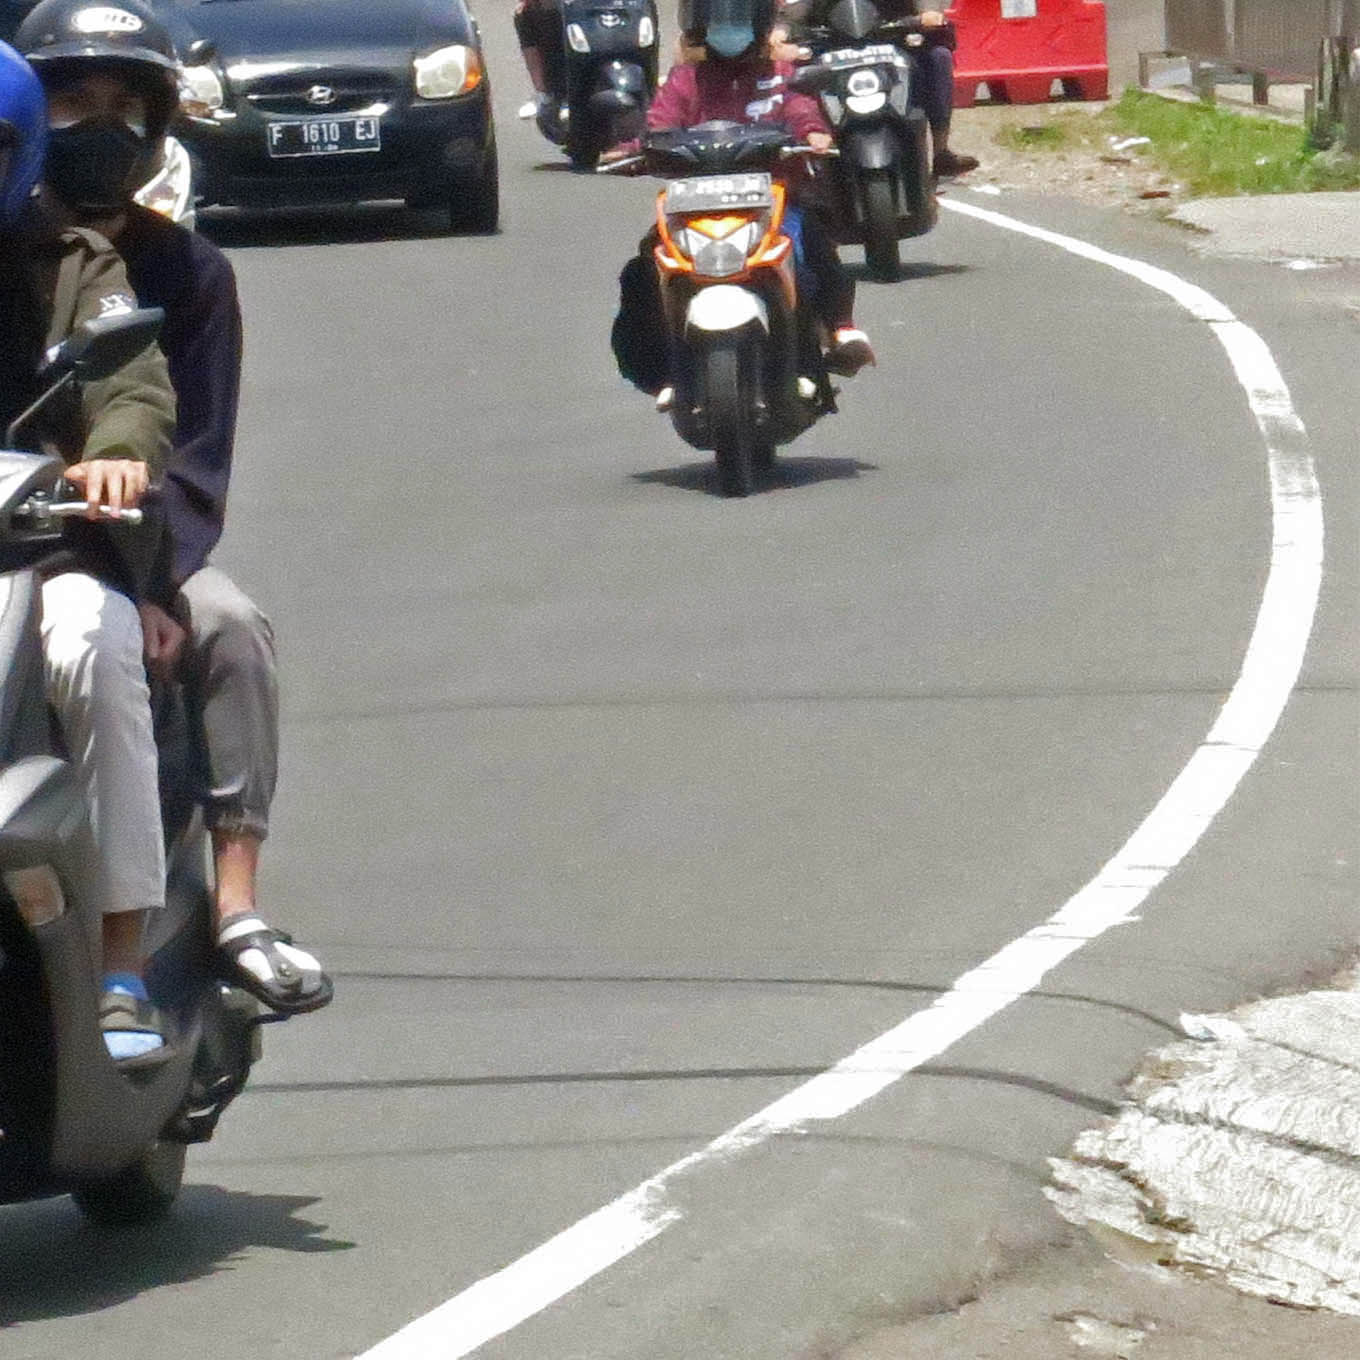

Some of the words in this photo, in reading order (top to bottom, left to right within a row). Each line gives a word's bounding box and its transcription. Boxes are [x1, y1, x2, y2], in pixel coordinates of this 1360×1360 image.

[271, 125, 283, 146] F
[301, 122, 341, 144] 1610
[355, 119, 377, 141] EJ
